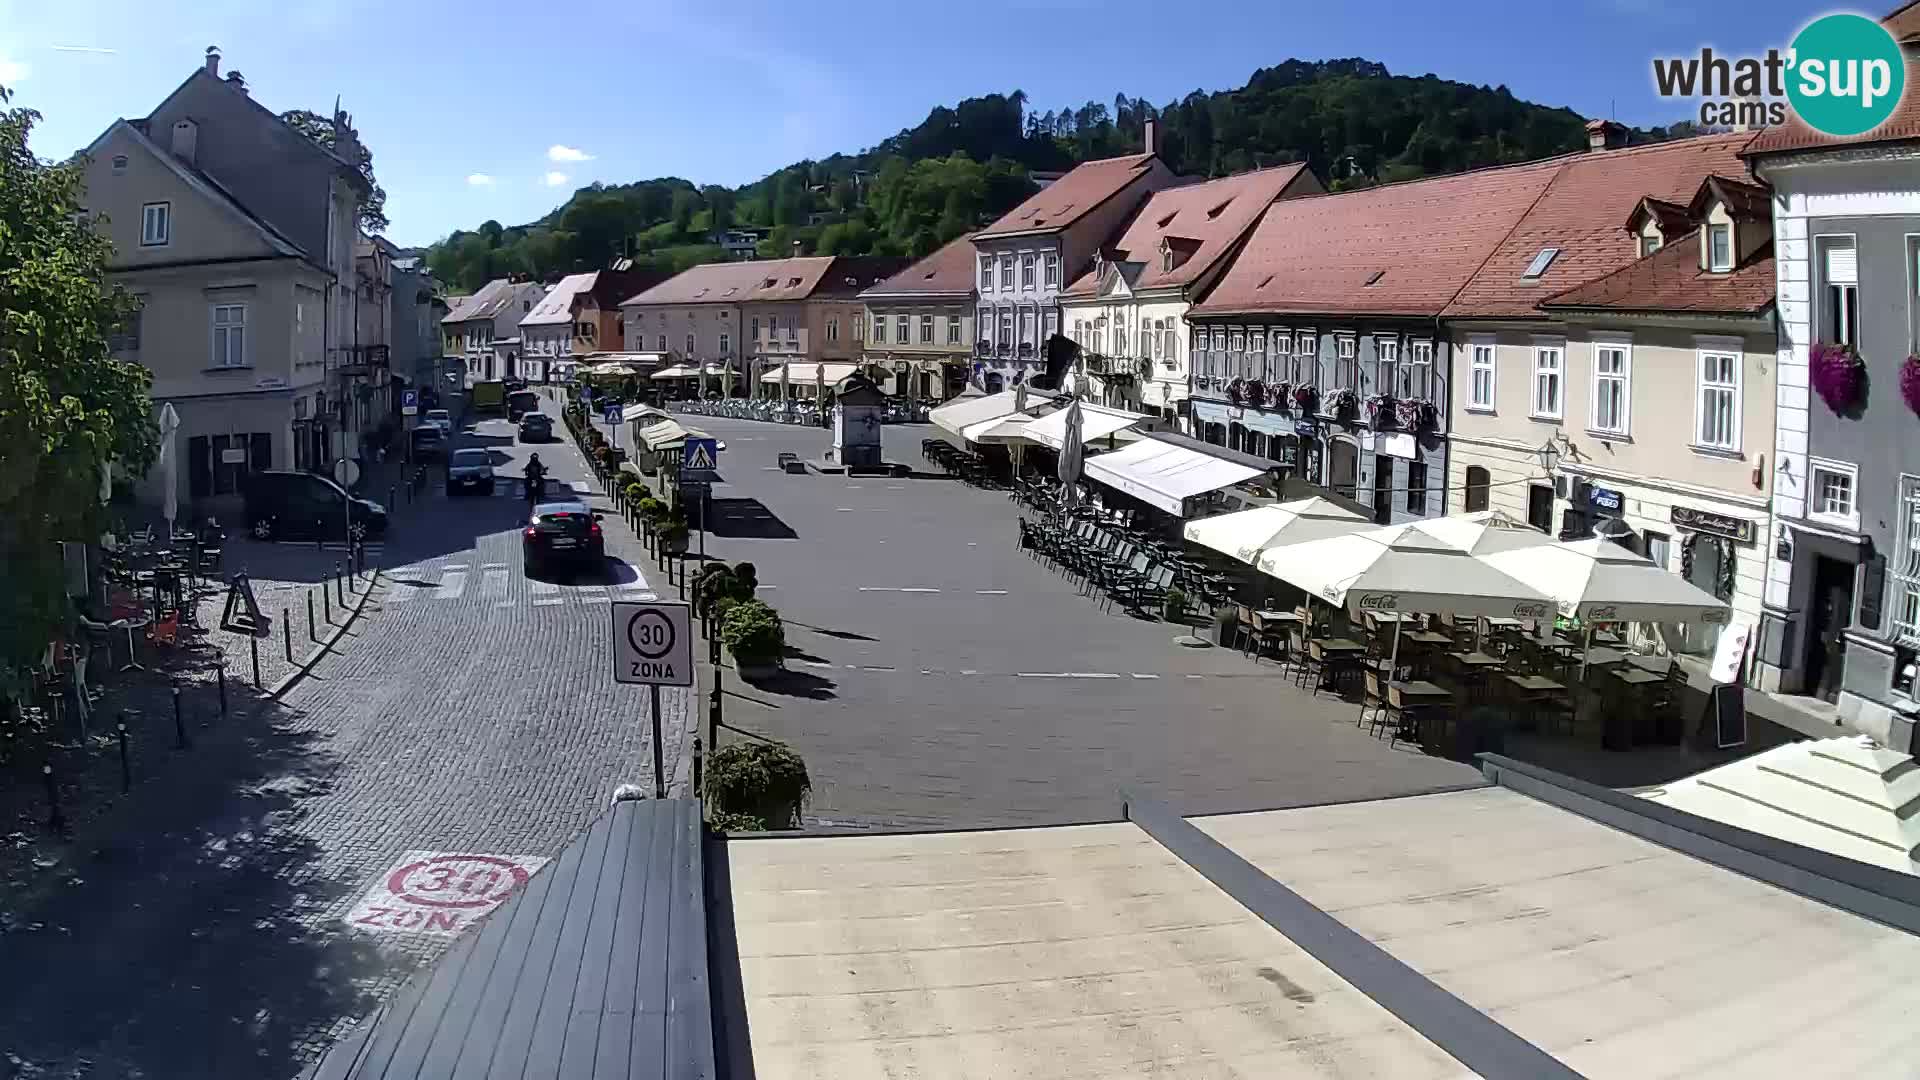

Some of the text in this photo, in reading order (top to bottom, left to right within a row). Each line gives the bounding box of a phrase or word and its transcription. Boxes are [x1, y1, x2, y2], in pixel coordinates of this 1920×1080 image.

[406, 393, 414, 404] P
[640, 624, 664, 646] 30
[631, 661, 674, 679] ZONA
[416, 867, 502, 896] 30
[354, 906, 466, 930] ZON
